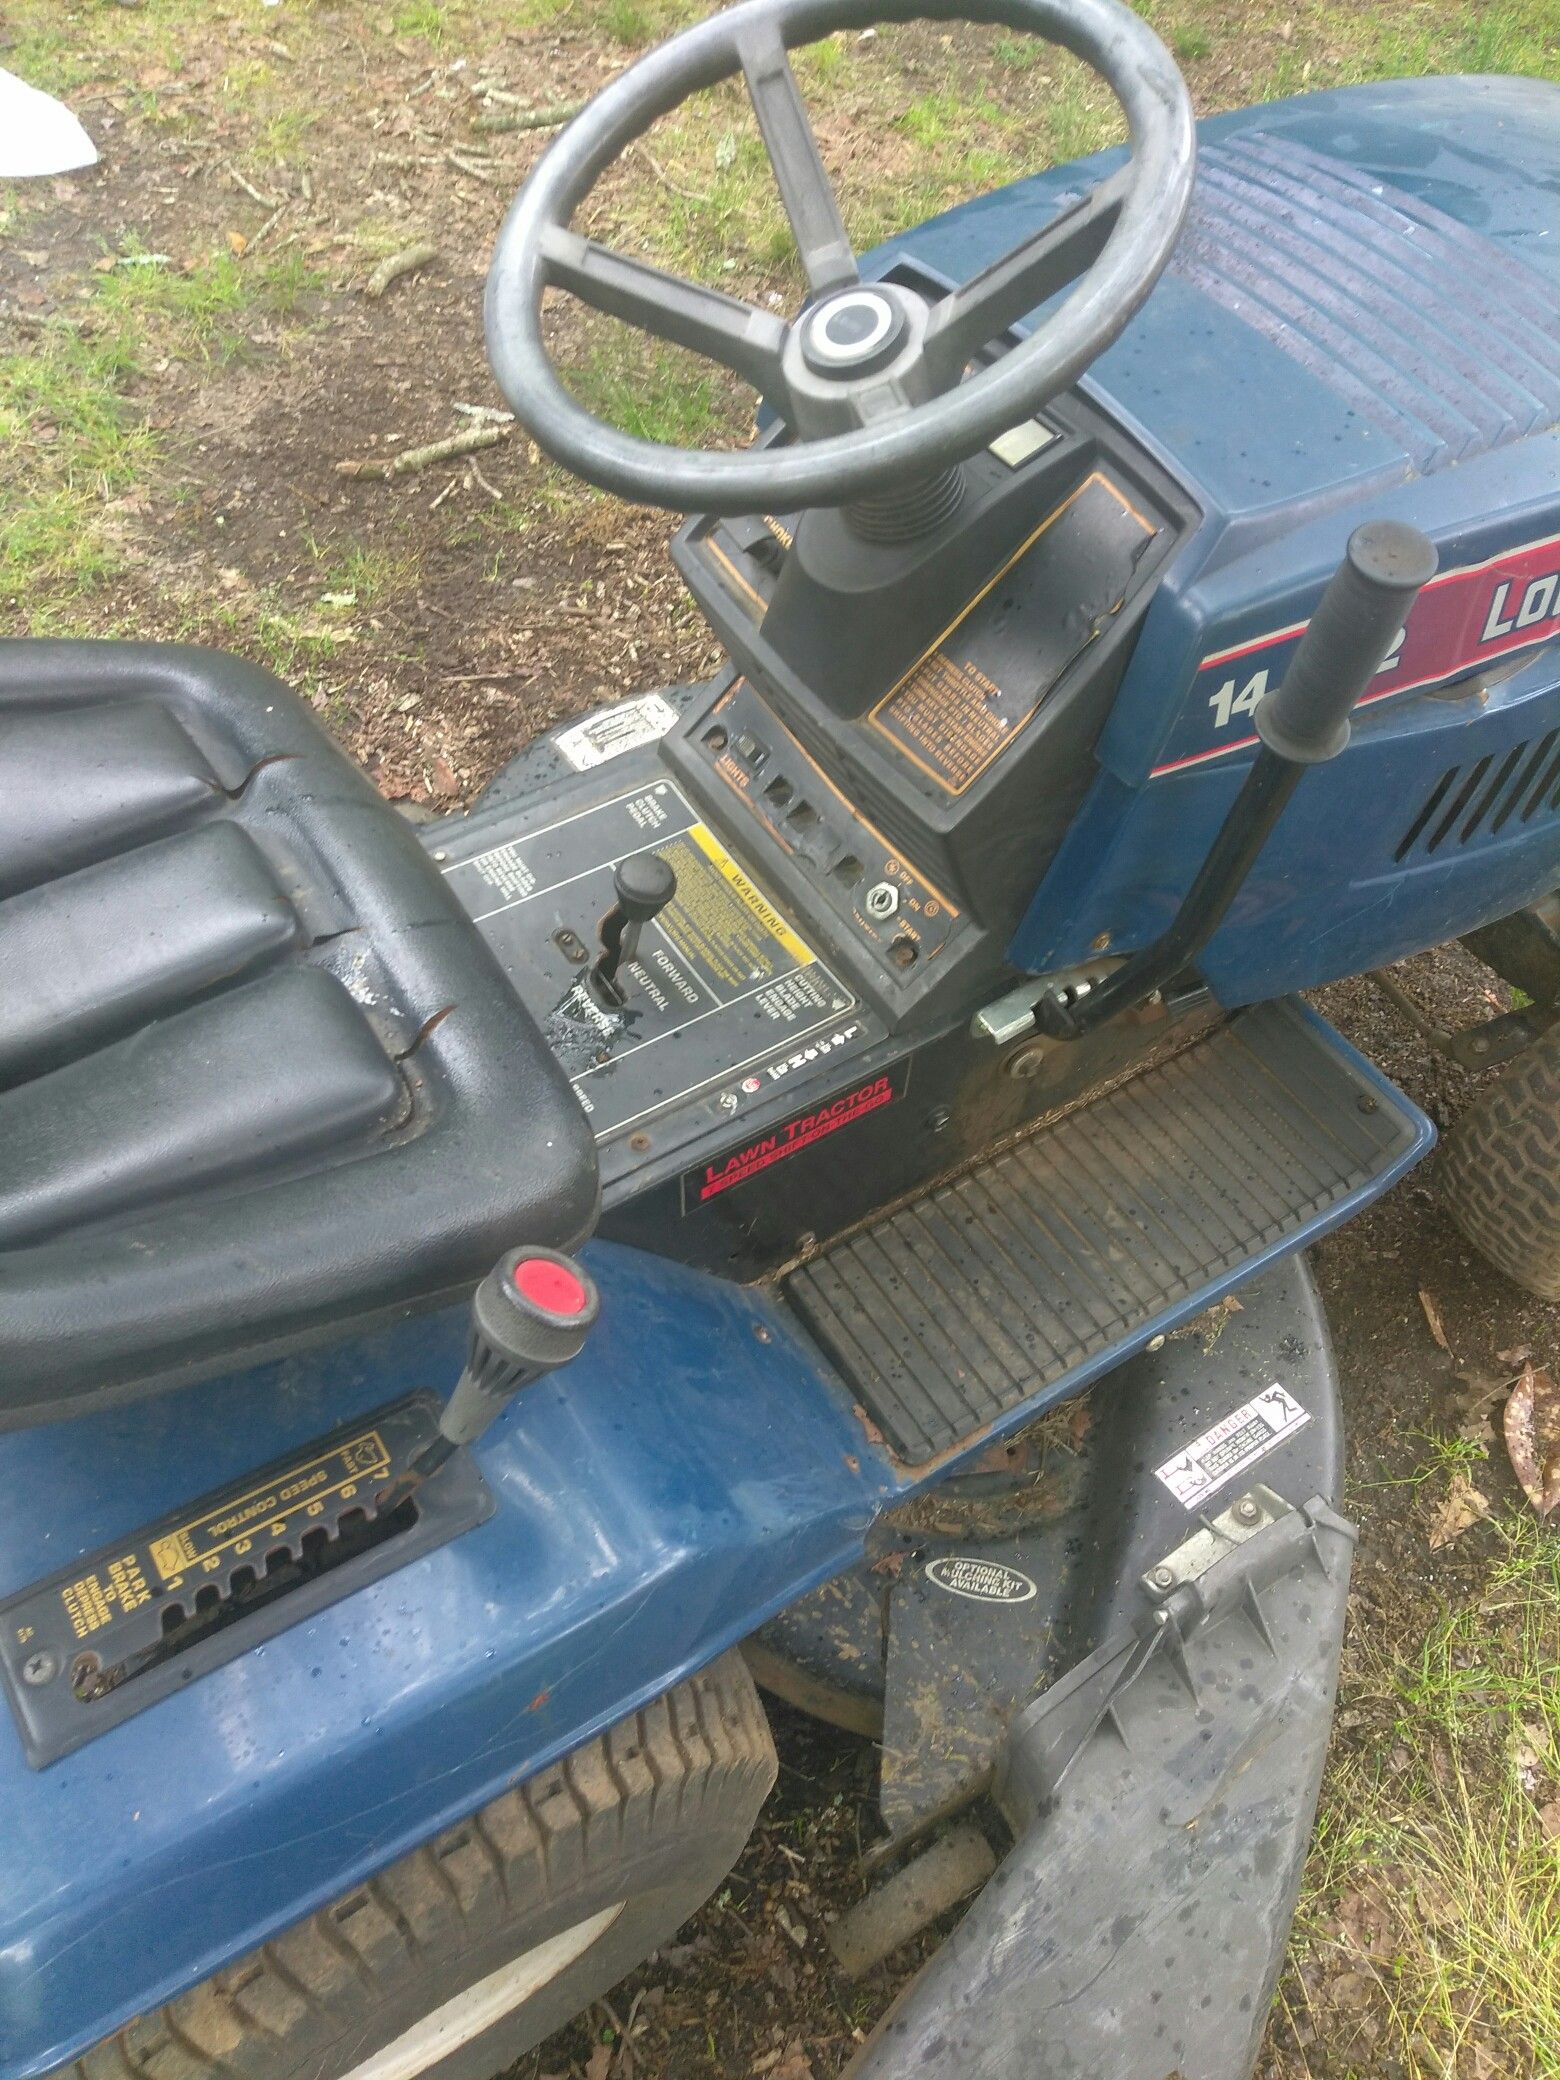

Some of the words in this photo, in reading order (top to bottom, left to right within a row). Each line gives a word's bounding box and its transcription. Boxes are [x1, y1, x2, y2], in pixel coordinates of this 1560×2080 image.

[1480, 573, 1560, 642] LO
[963, 661, 977, 675] TO
[974, 671, 999, 695] START
[1208, 669, 1269, 728] 14
[719, 753, 750, 787] LIGHTS
[625, 801, 647, 828] PEDAL
[730, 873, 787, 938] WARNING
[627, 961, 670, 1012] NEUTRAL
[651, 948, 699, 1005] FORWARD
[784, 977, 813, 1008] HEIGHT
[793, 972, 826, 1008] CUTTING
[571, 983, 615, 1038] REVERSE
[754, 993, 781, 1020] LEVER
[764, 988, 796, 1021] ENGAGE
[774, 983, 800, 1010] BLADE
[706, 1134, 775, 1183] LAWN
[782, 1075, 890, 1140] TRACTOR
[1206, 1408, 1251, 1445] DANGER
[277, 1469, 328, 1501] SPEED
[371, 1465, 390, 1481] 7
[341, 1484, 358, 1499] 6
[206, 1494, 278, 1537] CONTROL
[306, 1502, 325, 1517] 5
[271, 1521, 287, 1537] 4
[235, 1539, 252, 1555] 3
[121, 1553, 152, 1604] PARK
[202, 1556, 221, 1573] 2
[940, 1566, 1000, 1586] MULCHING
[1002, 1579, 1022, 1591] KIT
[954, 1560, 1009, 1579] OPTIONAL
[84, 1574, 112, 1625] ENGAGE
[102, 1583, 118, 1602] TO
[106, 1560, 138, 1612] BRAKE
[166, 1576, 184, 1591] 1
[949, 1577, 1010, 1598] AVAILABLE
[60, 1586, 88, 1638] CLUTCH
[72, 1580, 101, 1631] DEPRESS
